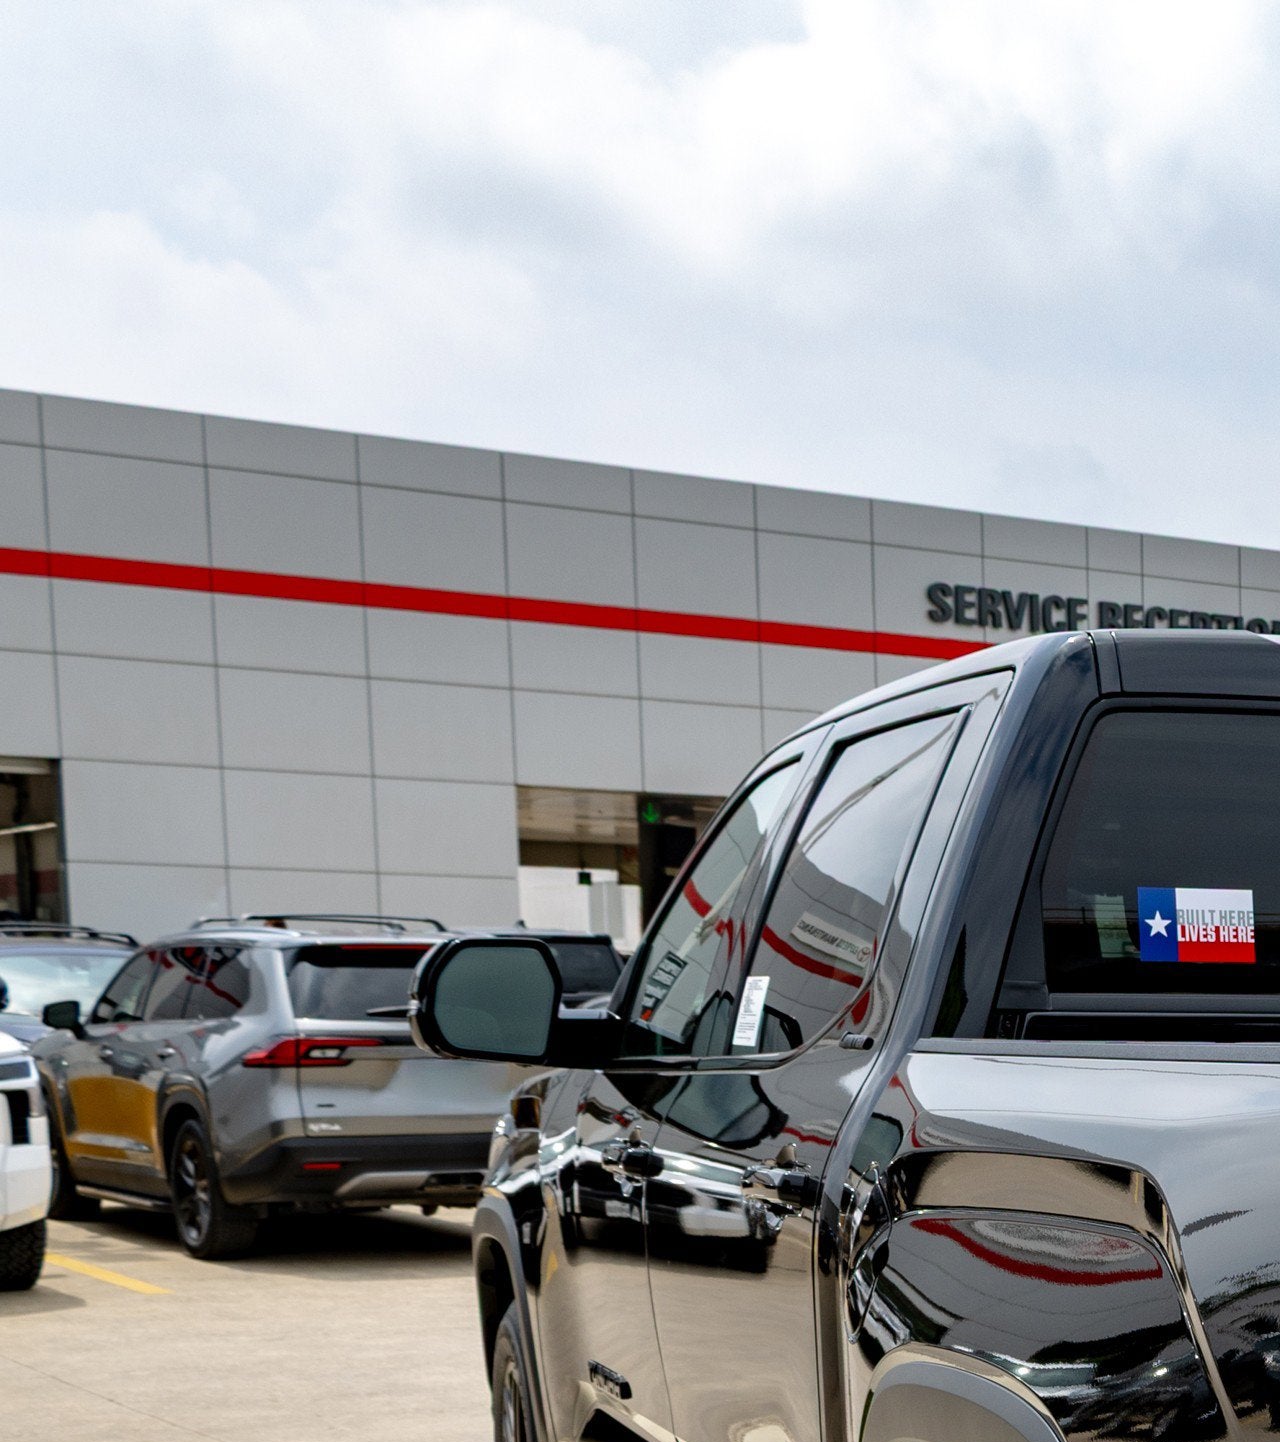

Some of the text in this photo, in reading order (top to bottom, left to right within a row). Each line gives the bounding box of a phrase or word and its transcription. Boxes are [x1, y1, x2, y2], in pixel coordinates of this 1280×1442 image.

[926, 582, 1088, 633] SERVICE
[1177, 909, 1254, 927] BUILT HERE
[1177, 925, 1256, 943] LIVES HERE
